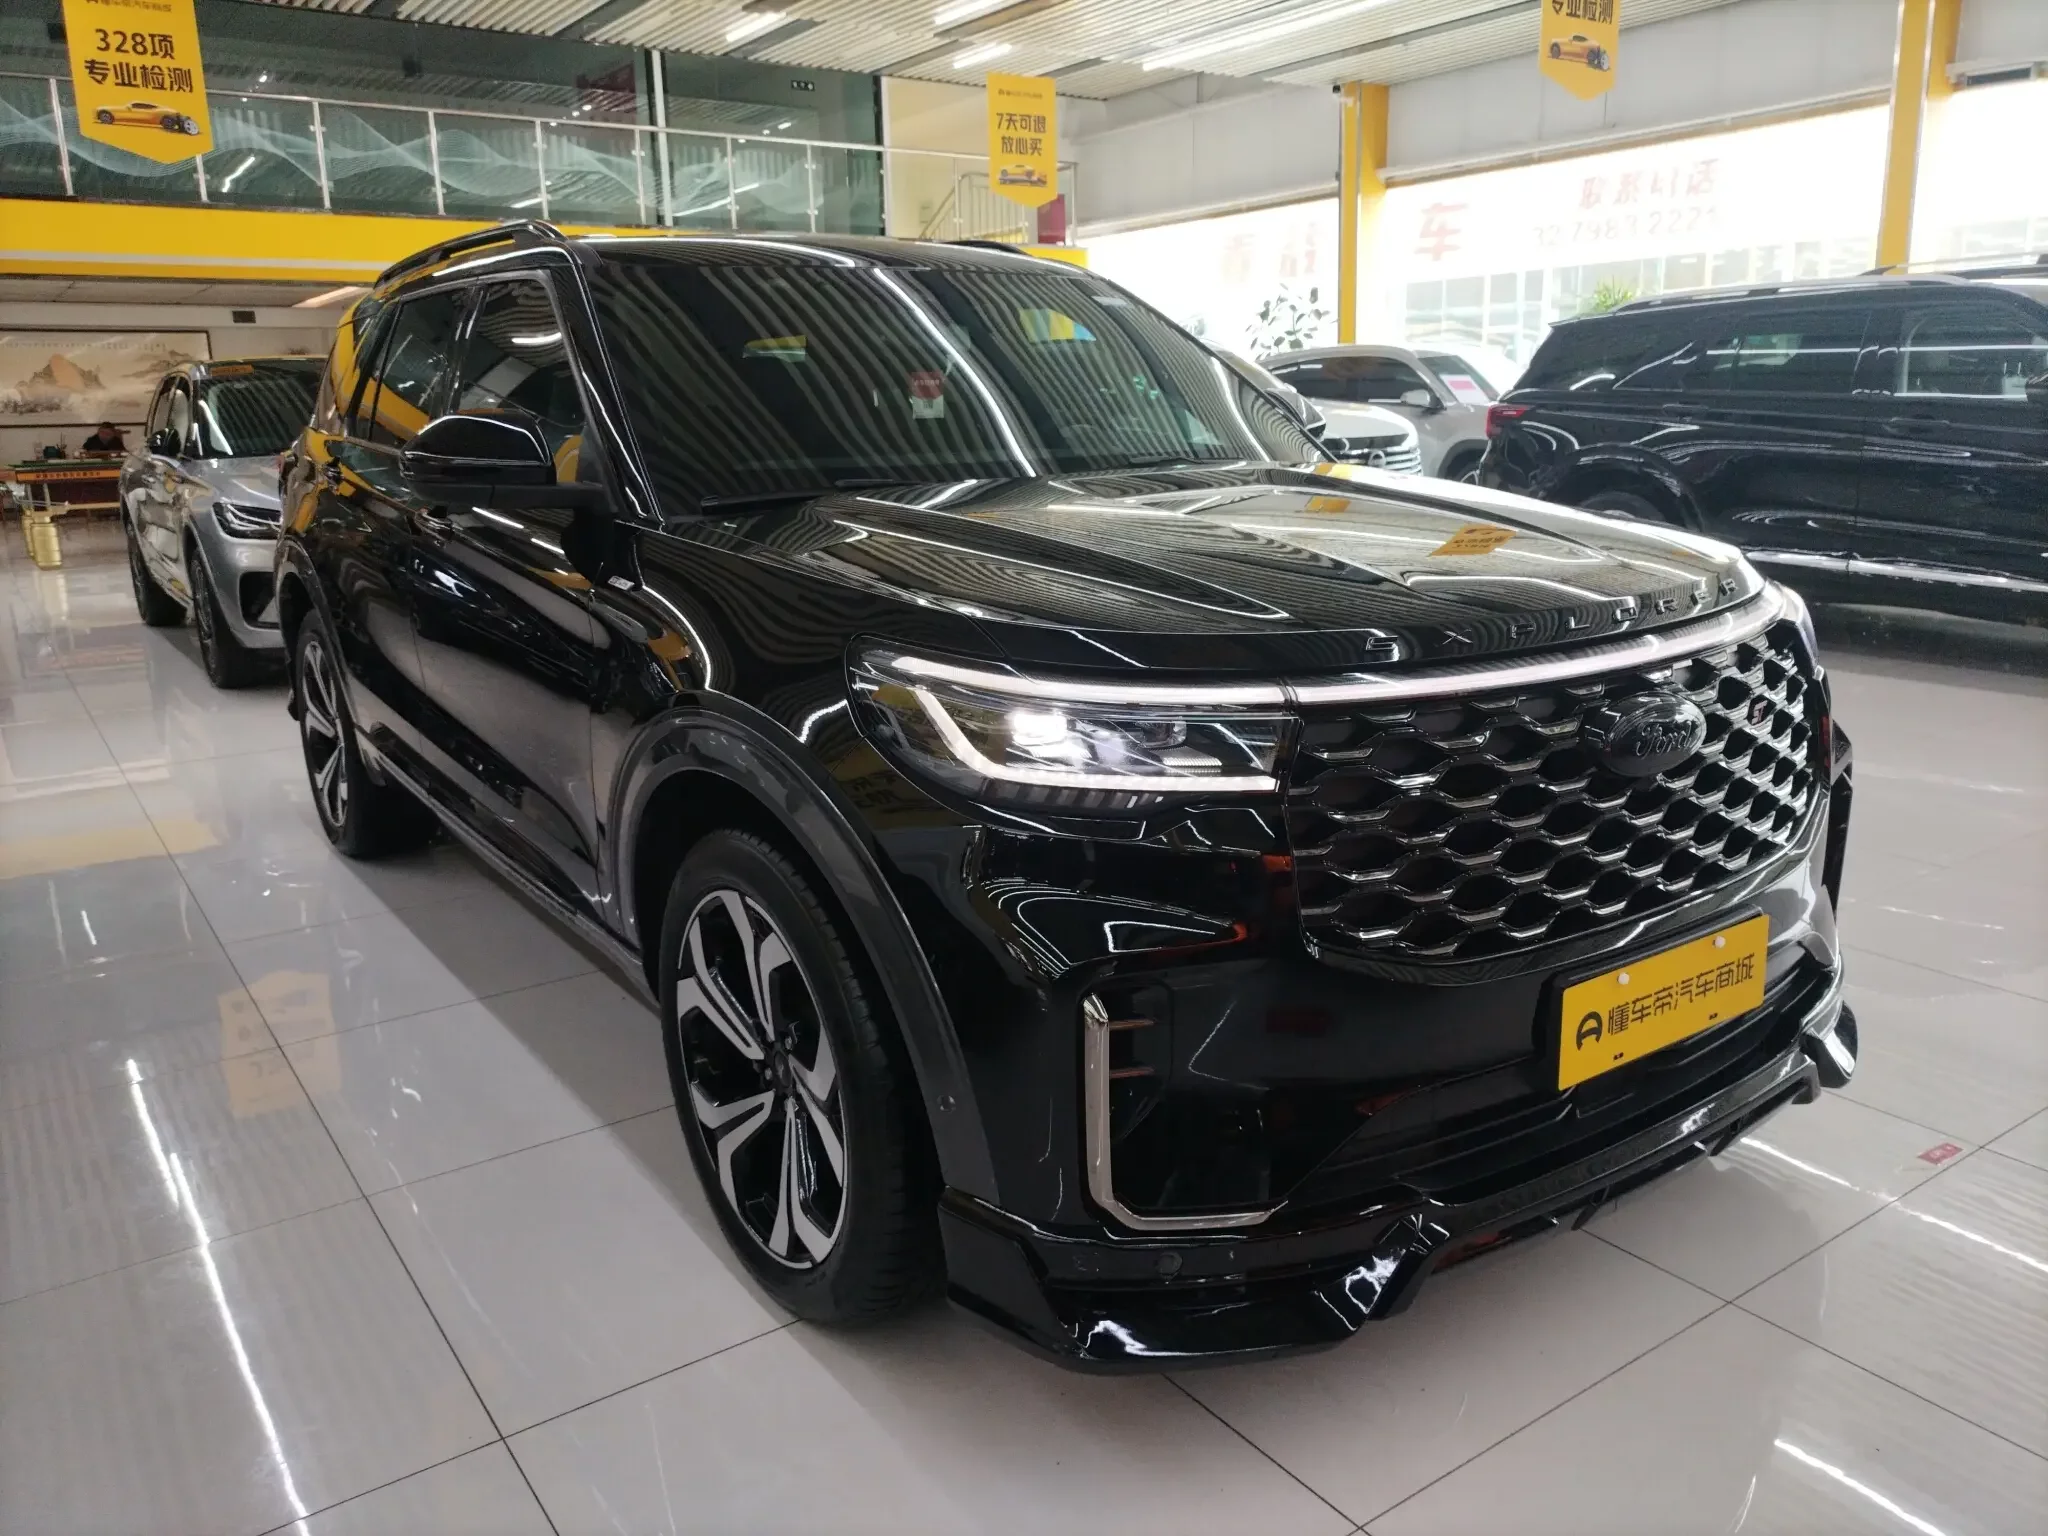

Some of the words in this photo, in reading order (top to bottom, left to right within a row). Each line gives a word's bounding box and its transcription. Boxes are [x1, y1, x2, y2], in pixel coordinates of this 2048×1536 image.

[95, 28, 175, 60] 328项
[84, 59, 193, 93] 专业检测
[1001, 135, 1042, 156] 放心买
[1366, 578, 1738, 651] EXPLORER
[1636, 720, 1692, 760] Ford
[1607, 953, 1755, 1036] 懂车帝汽车商城
